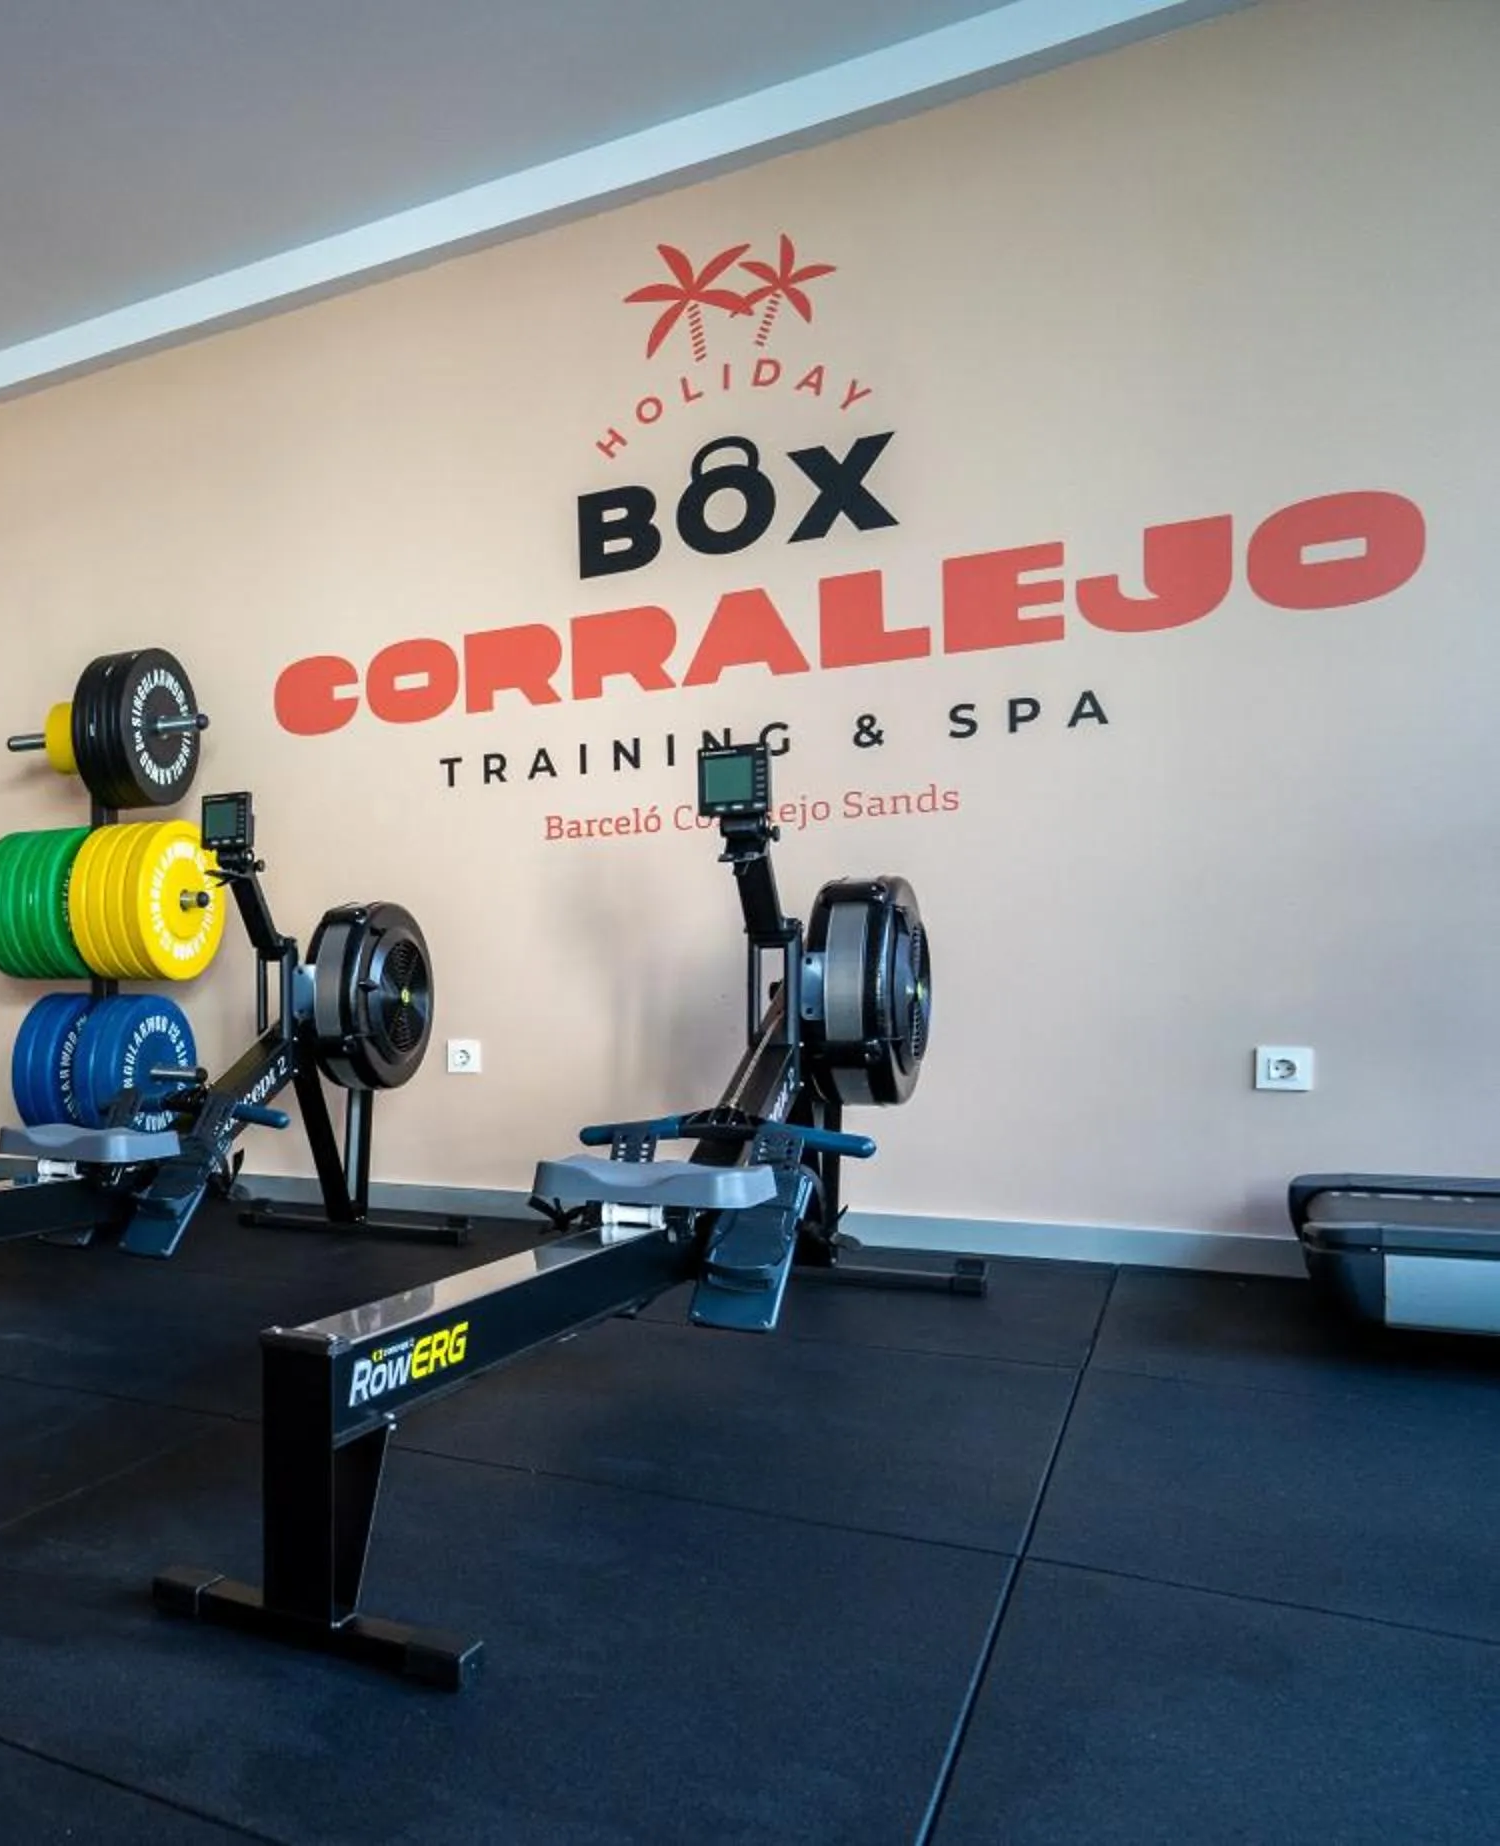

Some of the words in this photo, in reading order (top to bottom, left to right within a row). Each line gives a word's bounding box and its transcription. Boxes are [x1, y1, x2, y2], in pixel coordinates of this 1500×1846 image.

[594, 357, 872, 460] HOLIDAY
[577, 431, 900, 580] BOX
[272, 490, 1426, 738] CORRALEJO
[853, 714, 884, 749] &
[949, 690, 1110, 739] SPA
[544, 806, 663, 841] Barceló
[673, 796, 832, 832] Coejo
[843, 783, 961, 819] Sands
